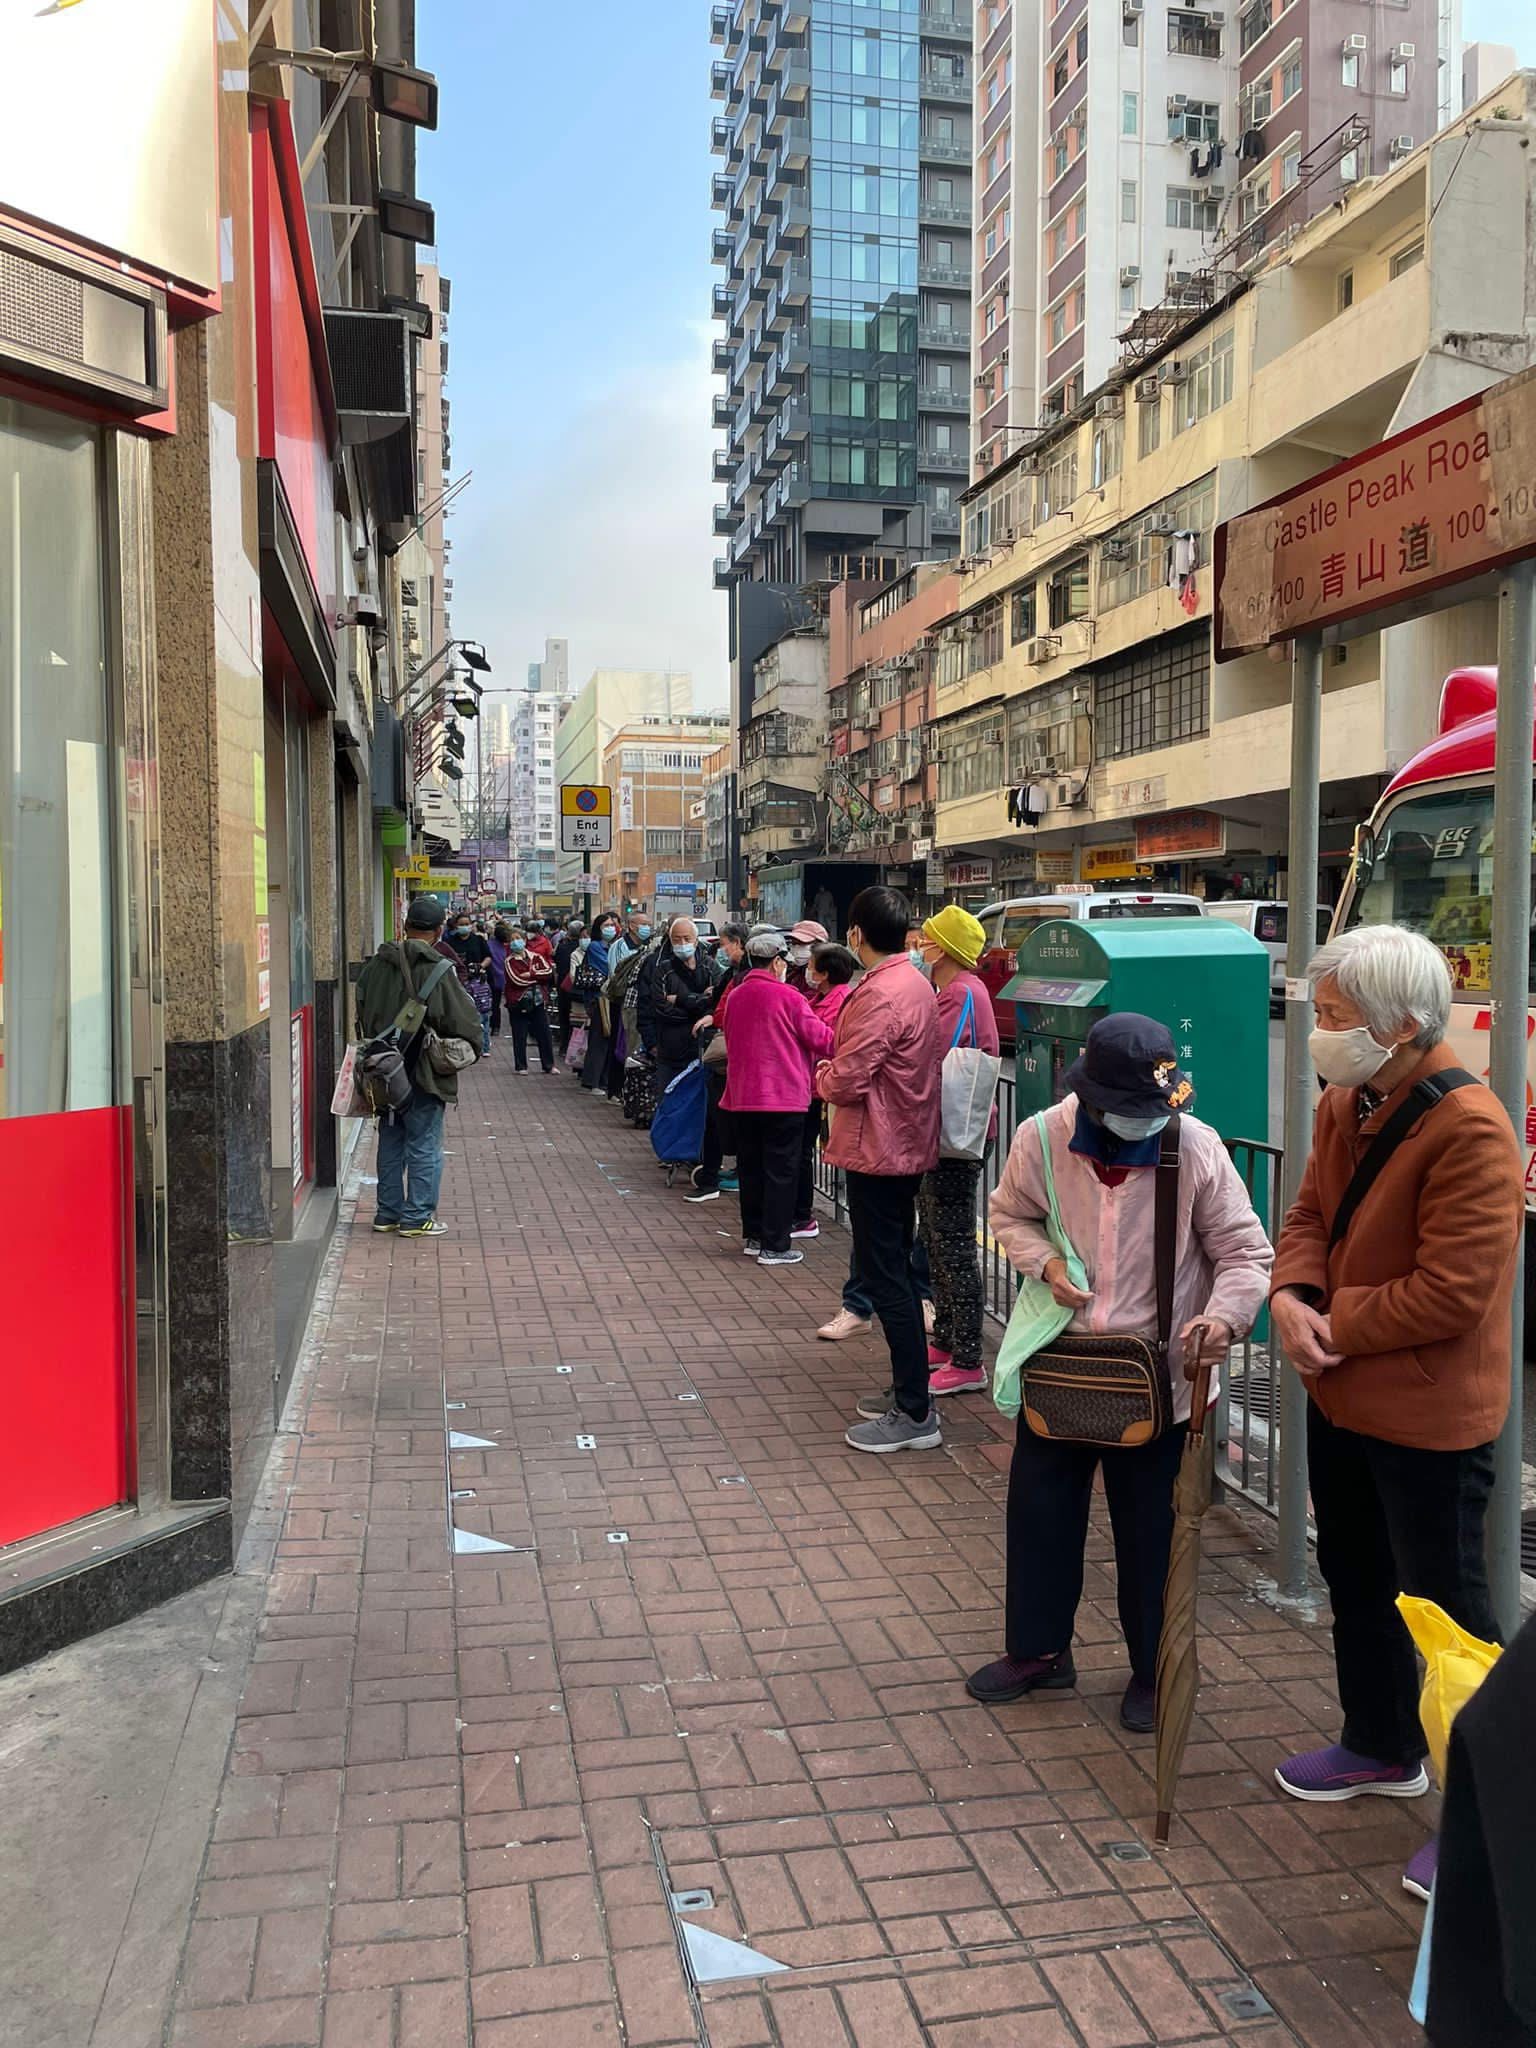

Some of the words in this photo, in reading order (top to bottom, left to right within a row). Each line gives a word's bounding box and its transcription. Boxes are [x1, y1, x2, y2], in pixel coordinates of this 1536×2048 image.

[1265, 498, 1337, 552] Castle
[1347, 460, 1416, 518] Peak
[1427, 413, 1511, 484] Road
[1320, 516, 1434, 603] 青山道
[576, 820, 599, 830] End
[572, 833, 602, 847] 終止
[1024, 1056, 1037, 1073] 127
